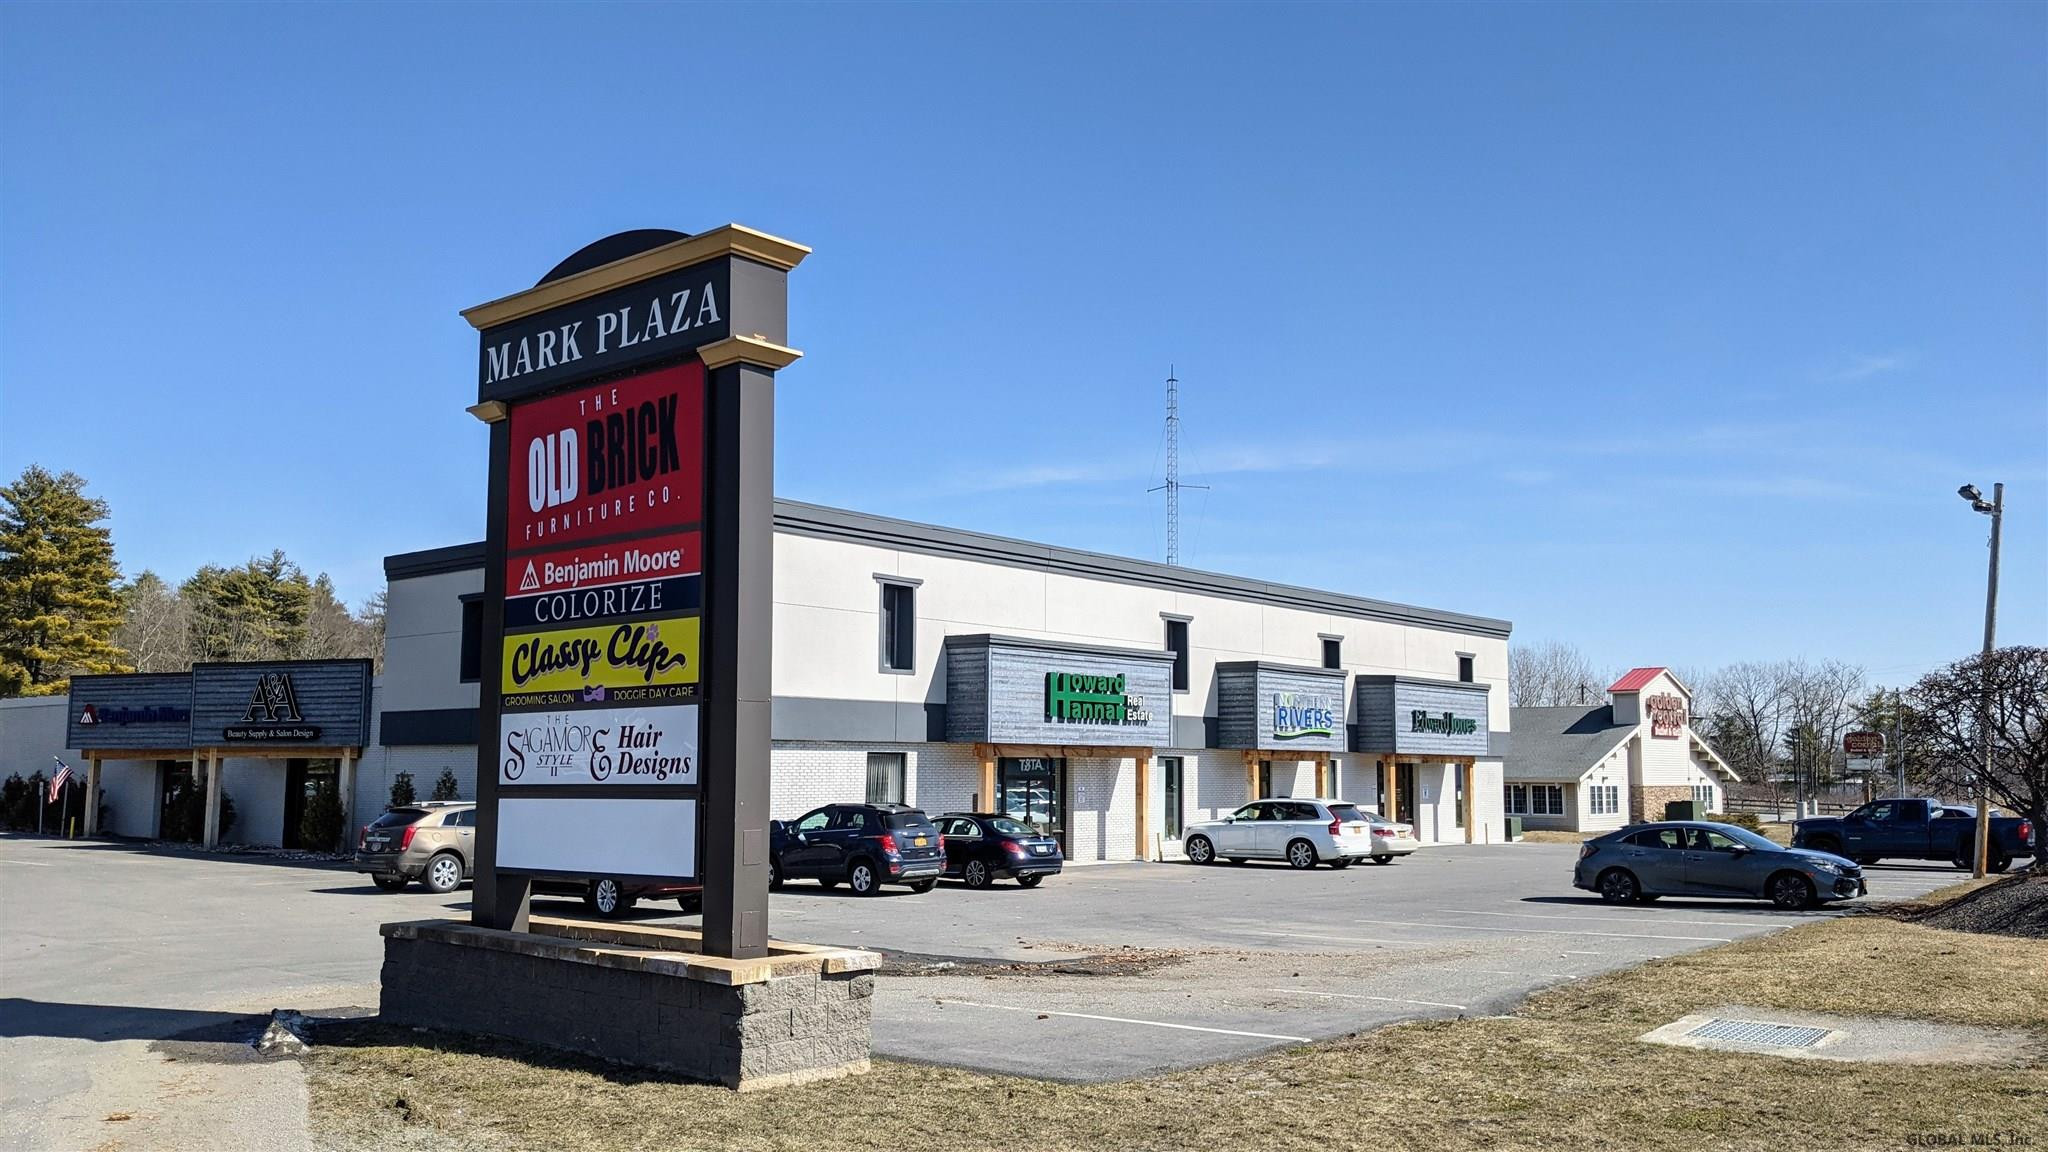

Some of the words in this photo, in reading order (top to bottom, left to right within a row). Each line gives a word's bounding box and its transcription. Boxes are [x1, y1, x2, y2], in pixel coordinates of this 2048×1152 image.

[485, 321, 583, 385] MARK
[595, 280, 722, 355] PLAZA
[579, 389, 619, 416] THE
[528, 427, 579, 513] OLD
[586, 393, 681, 496] BRICK
[526, 495, 636, 541] FURNITURE
[648, 485, 682, 508] CO.
[543, 553, 619, 588] Benjamin
[623, 548, 682, 575] Moore
[535, 582, 663, 623] COLORIZE
[511, 637, 602, 688] Classy
[606, 624, 688, 684] Clip
[504, 694, 547, 707] GROOMING
[547, 693, 575, 705] SALON
[613, 689, 647, 701] DOGGIE
[649, 687, 668, 699] DAY
[669, 686, 695, 698] CARE
[1126, 695, 1144, 707] Real
[547, 714, 570, 725] THE
[1126, 708, 1153, 721] Estate
[1279, 706, 1333, 728] RIVERS
[227, 729, 247, 739] Beauty
[248, 729, 268, 739] Supply
[276, 729, 292, 737] Salon
[293, 729, 314, 739] Design
[617, 723, 663, 750] Hair
[504, 725, 612, 781] SAGAMORE
[536, 754, 574, 766] STYLE
[616, 750, 692, 781] Designs
